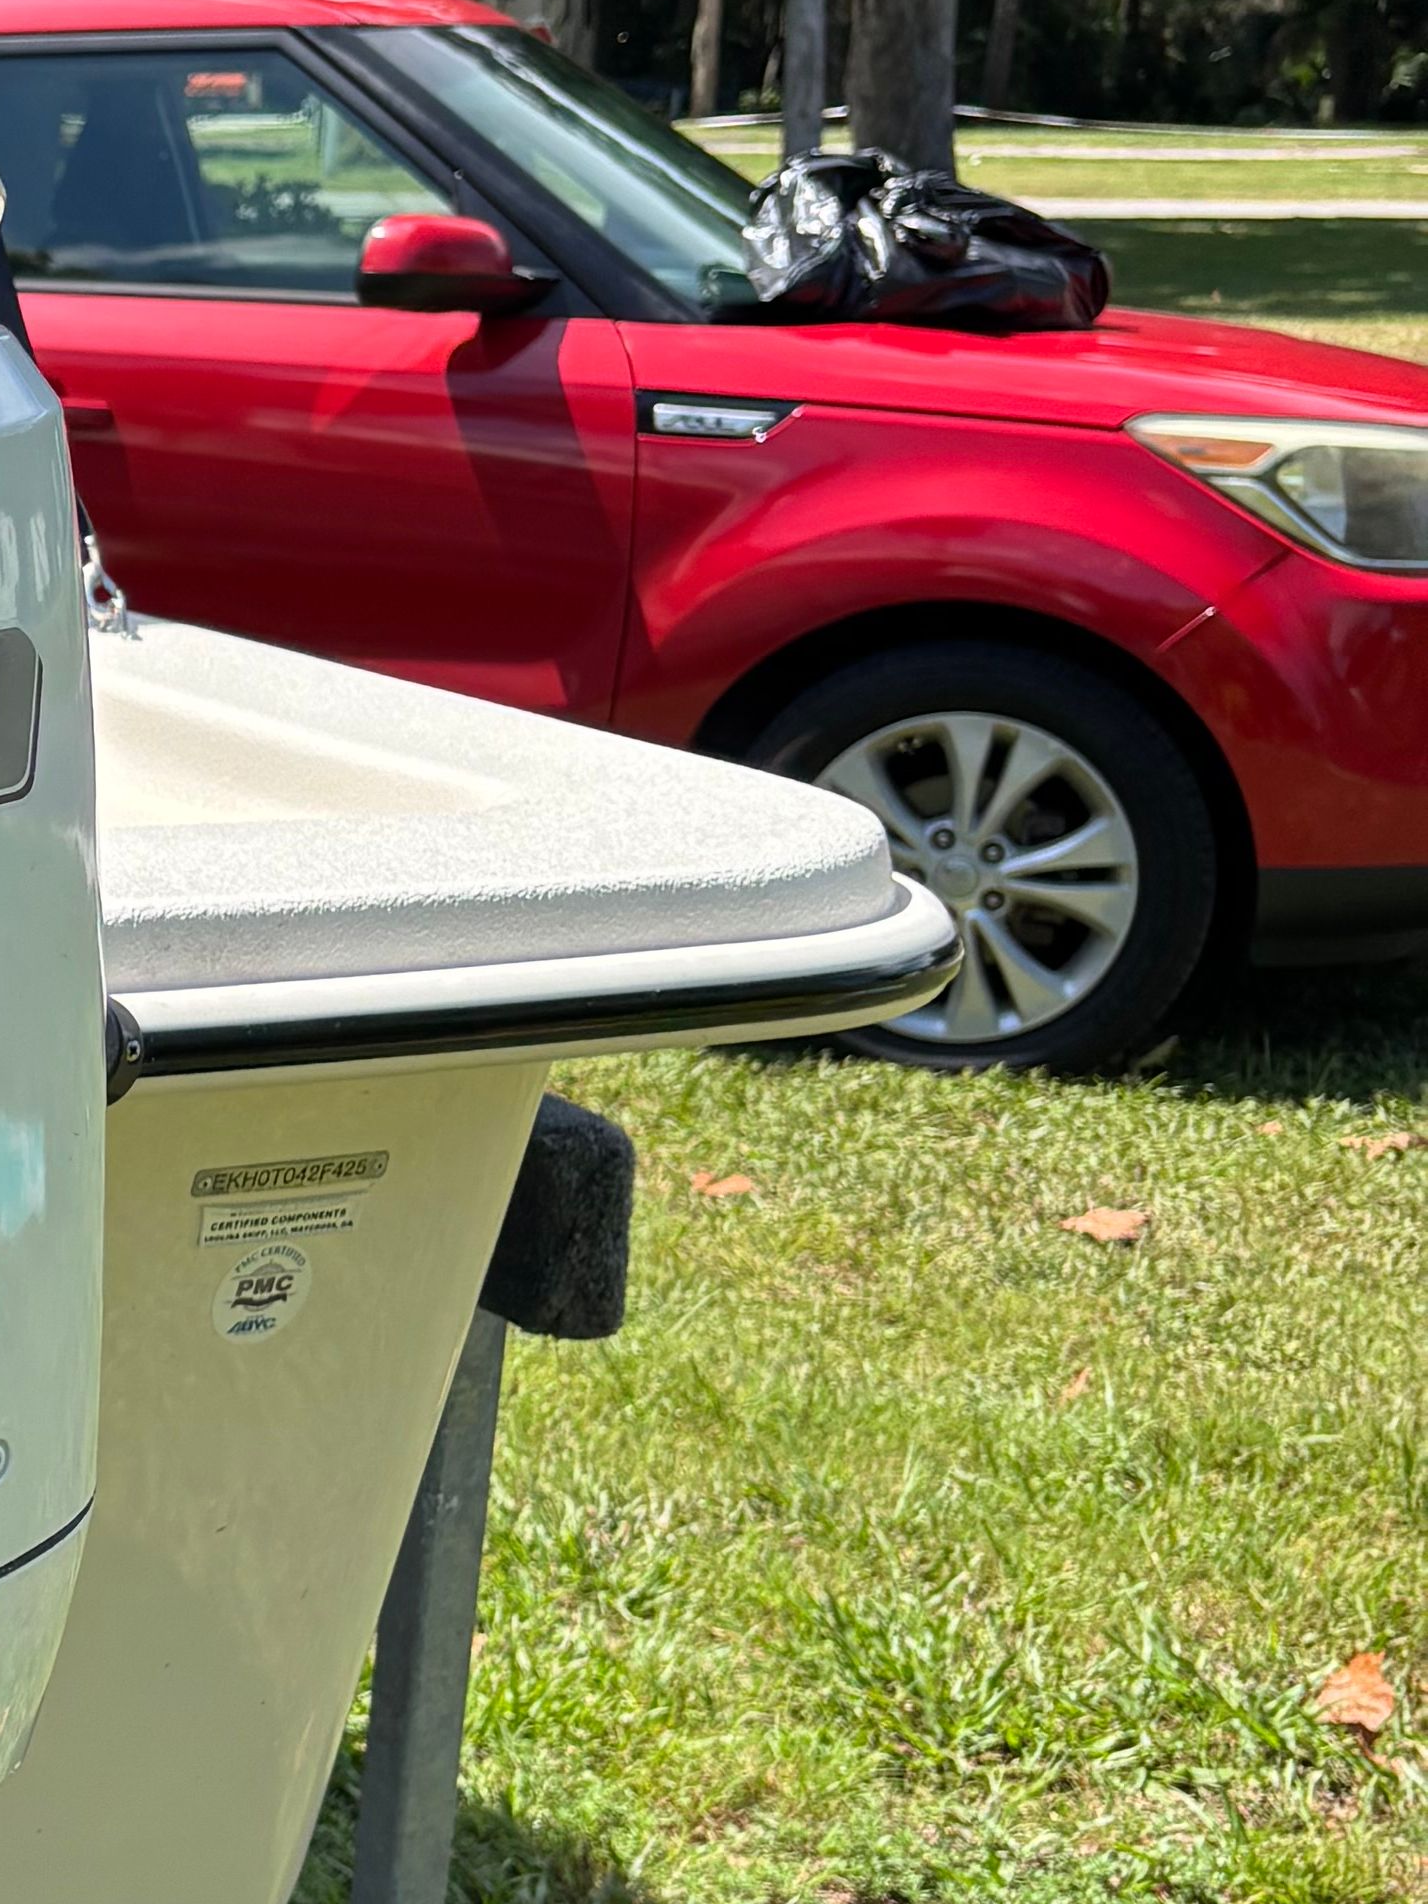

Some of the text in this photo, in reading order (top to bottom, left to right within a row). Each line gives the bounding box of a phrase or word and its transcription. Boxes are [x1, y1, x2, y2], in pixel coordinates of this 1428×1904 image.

[210, 1207, 347, 1232] CERTIFIED COMPONENTS
[236, 1274, 295, 1298] PMC
